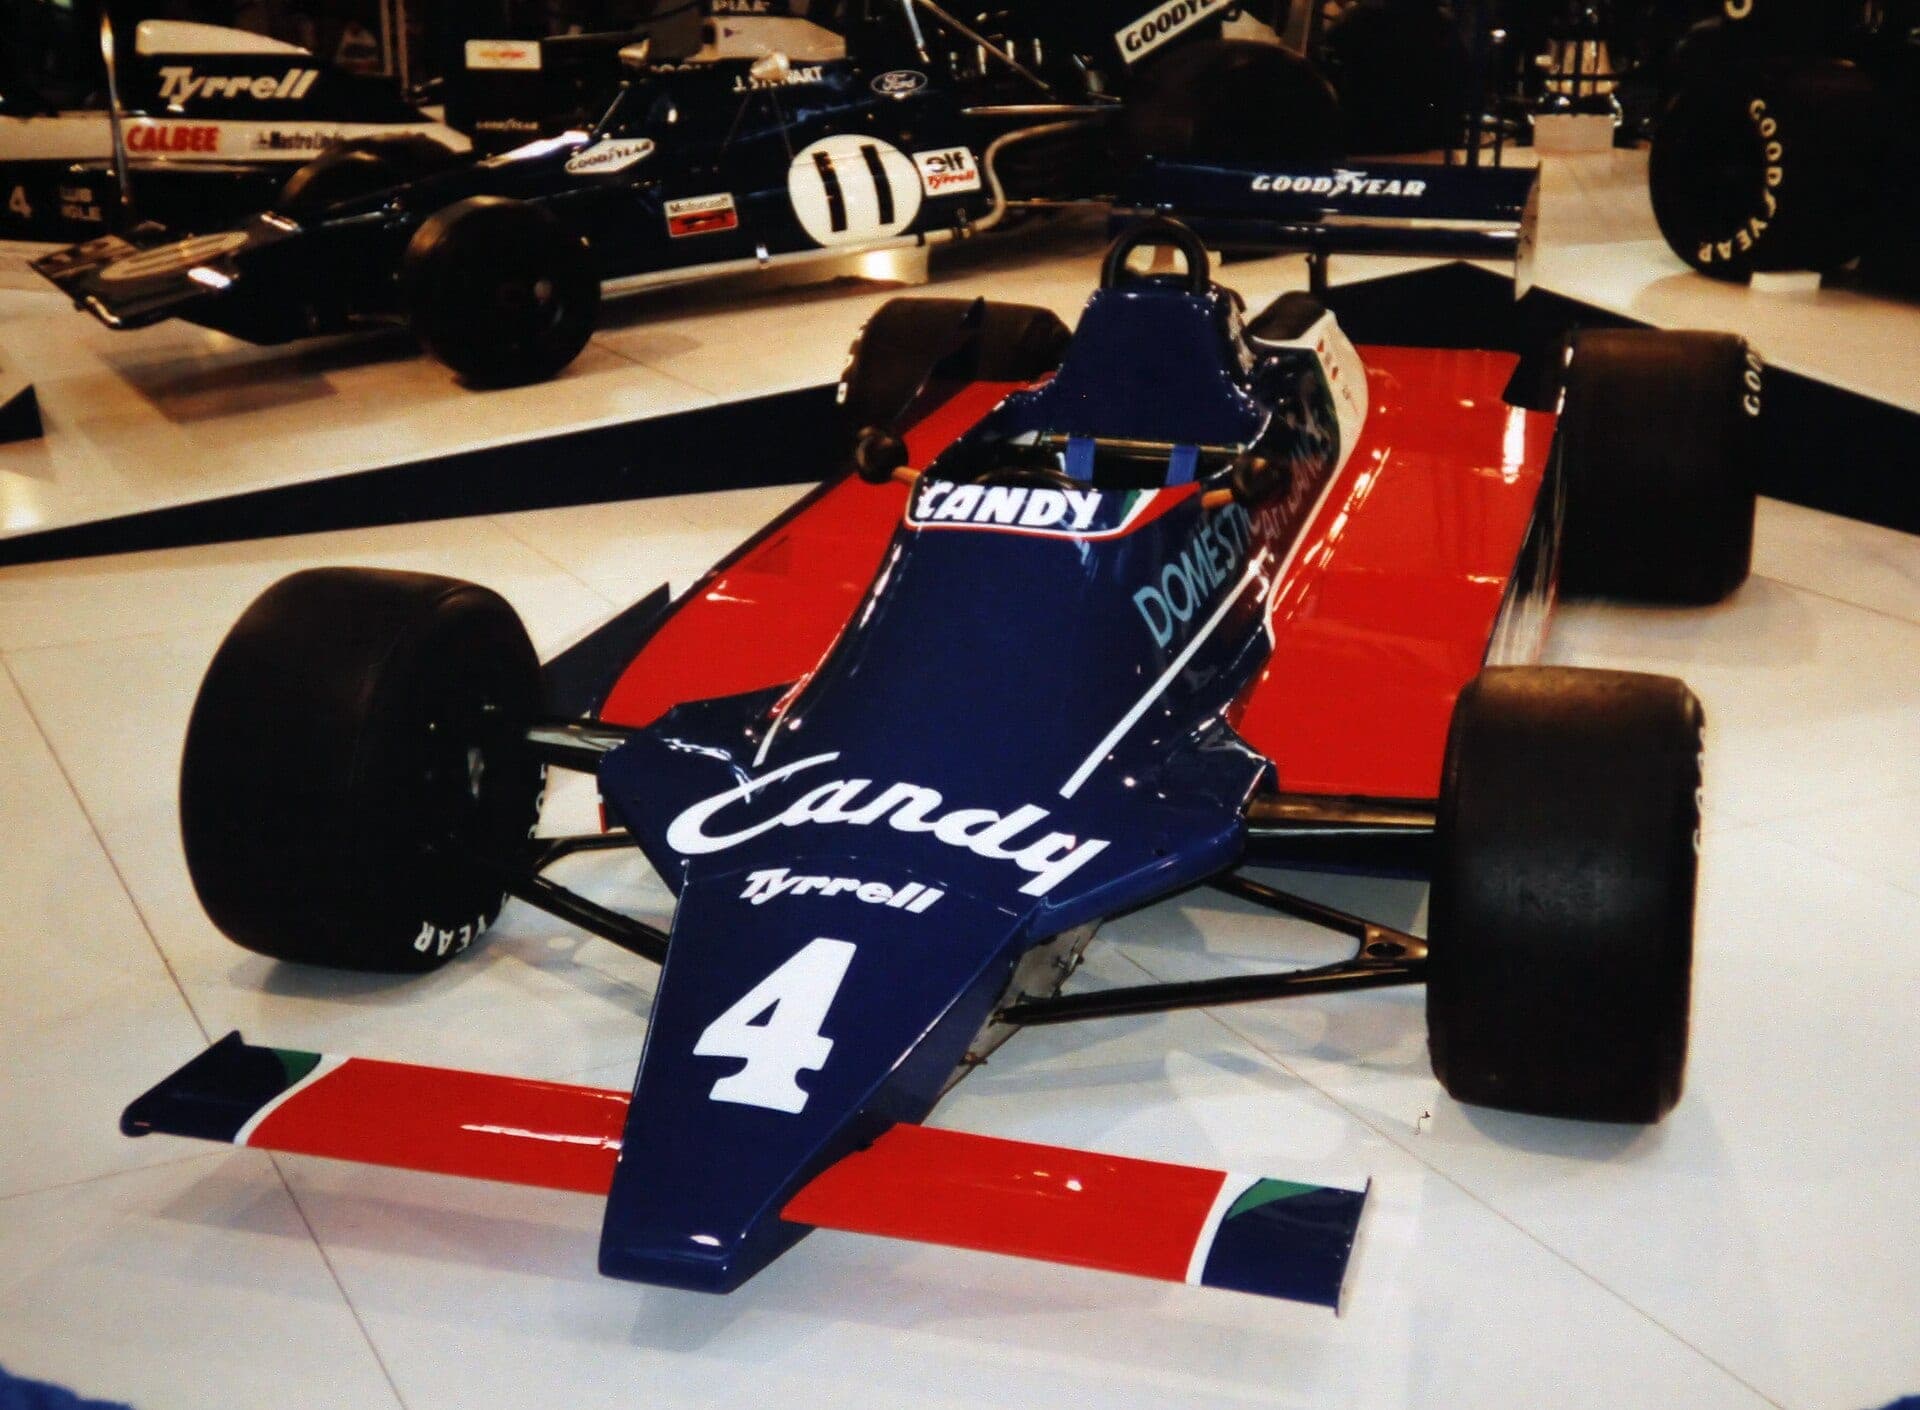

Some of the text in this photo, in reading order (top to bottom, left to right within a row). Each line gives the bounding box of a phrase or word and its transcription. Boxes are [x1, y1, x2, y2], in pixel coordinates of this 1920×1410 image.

[158, 67, 320, 112] Tyrrell
[127, 126, 219, 152] CALBEE
[566, 140, 652, 170] GOODYEAR
[926, 151, 965, 173] elf
[1252, 168, 1426, 197] GOODYEAR
[8, 185, 33, 219] 4
[812, 144, 894, 232] 11
[915, 481, 1102, 529] CANDY
[667, 751, 1110, 897] Candy
[739, 868, 944, 913] Tyrrell
[693, 937, 860, 1113] 4
